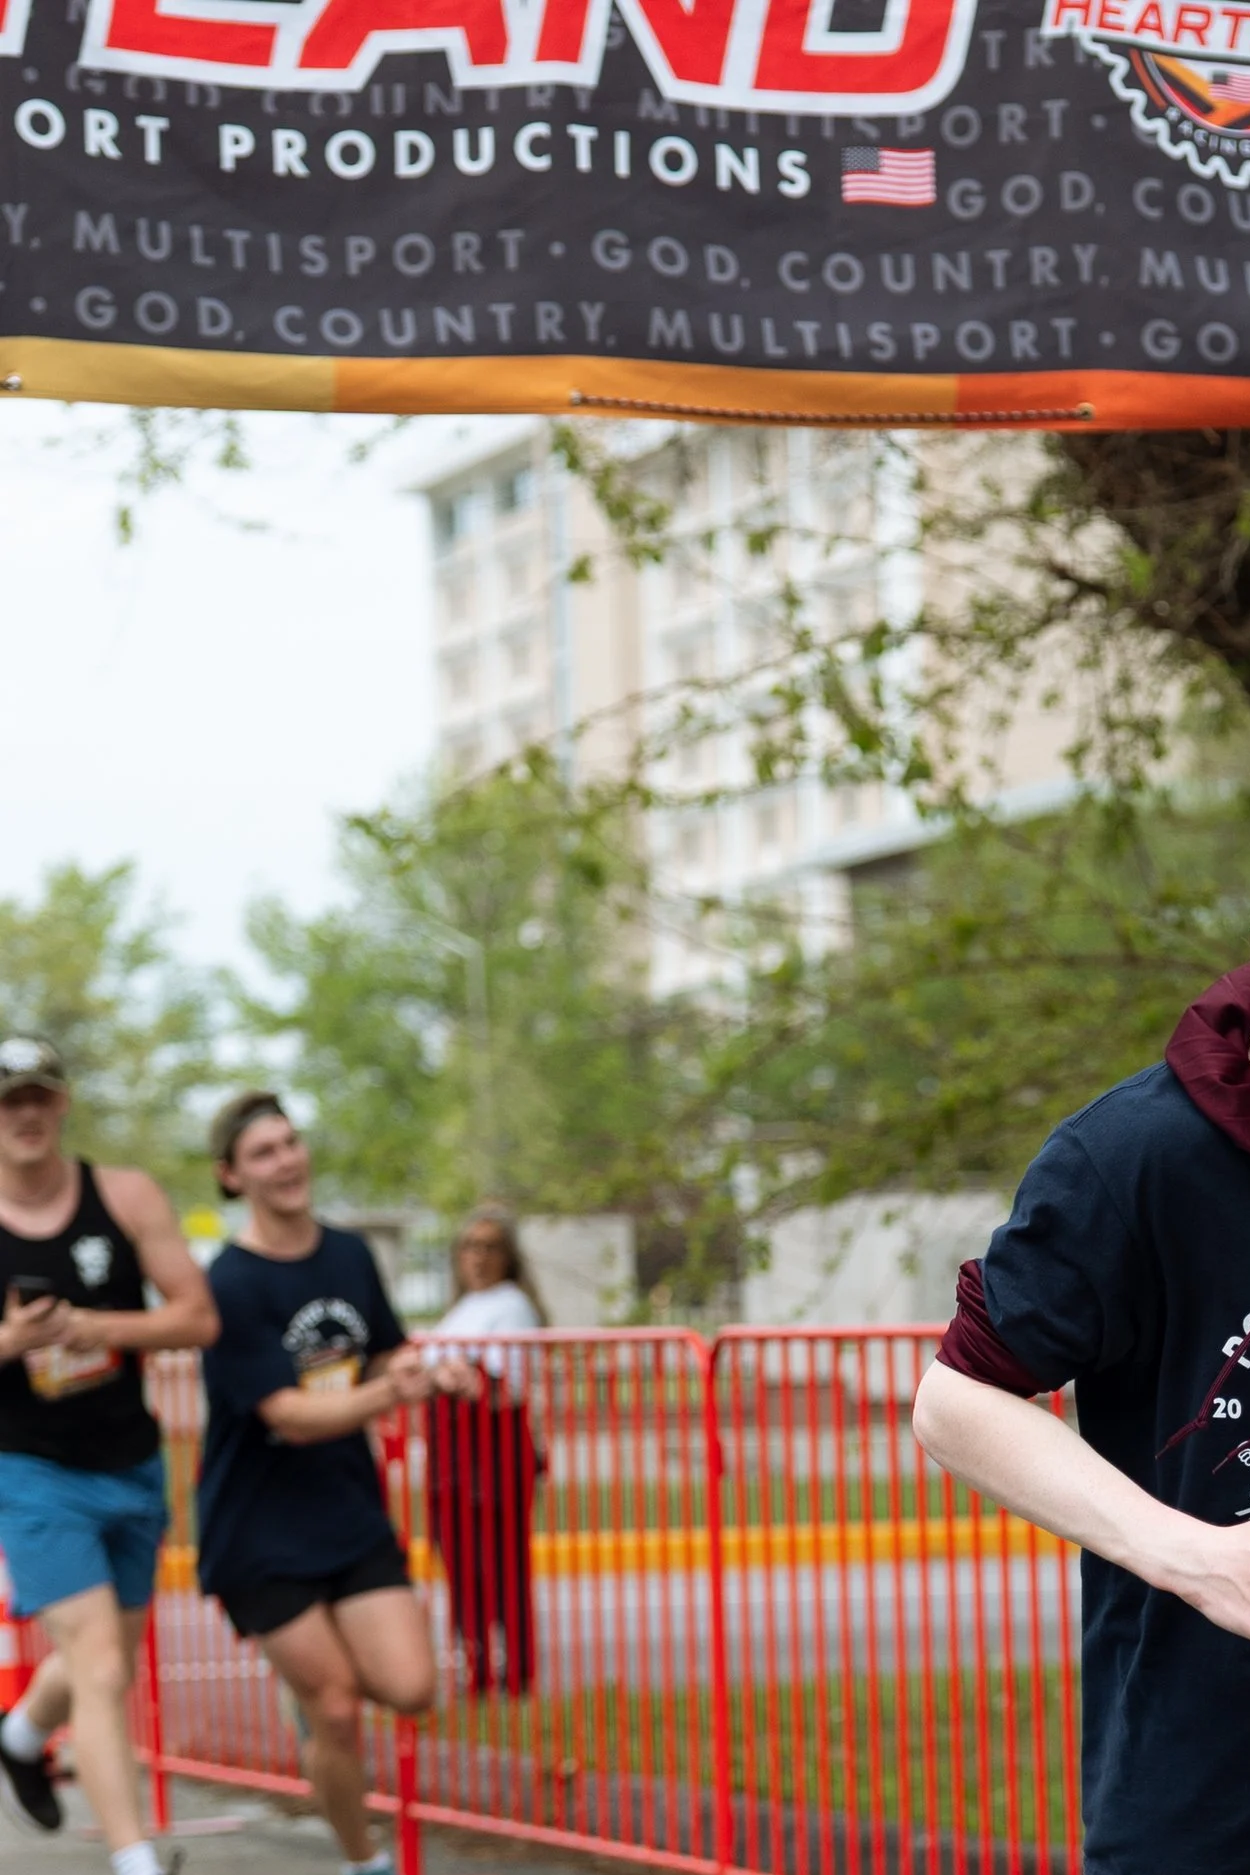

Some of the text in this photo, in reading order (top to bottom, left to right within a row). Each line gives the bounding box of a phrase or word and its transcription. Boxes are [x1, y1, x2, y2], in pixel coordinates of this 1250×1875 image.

[218, 121, 811, 199] PRODUCTIONS
[73, 210, 526, 277] MULTISPORT
[648, 306, 1076, 361] MULTISPORT
[1212, 1397, 1242, 1419] 20
